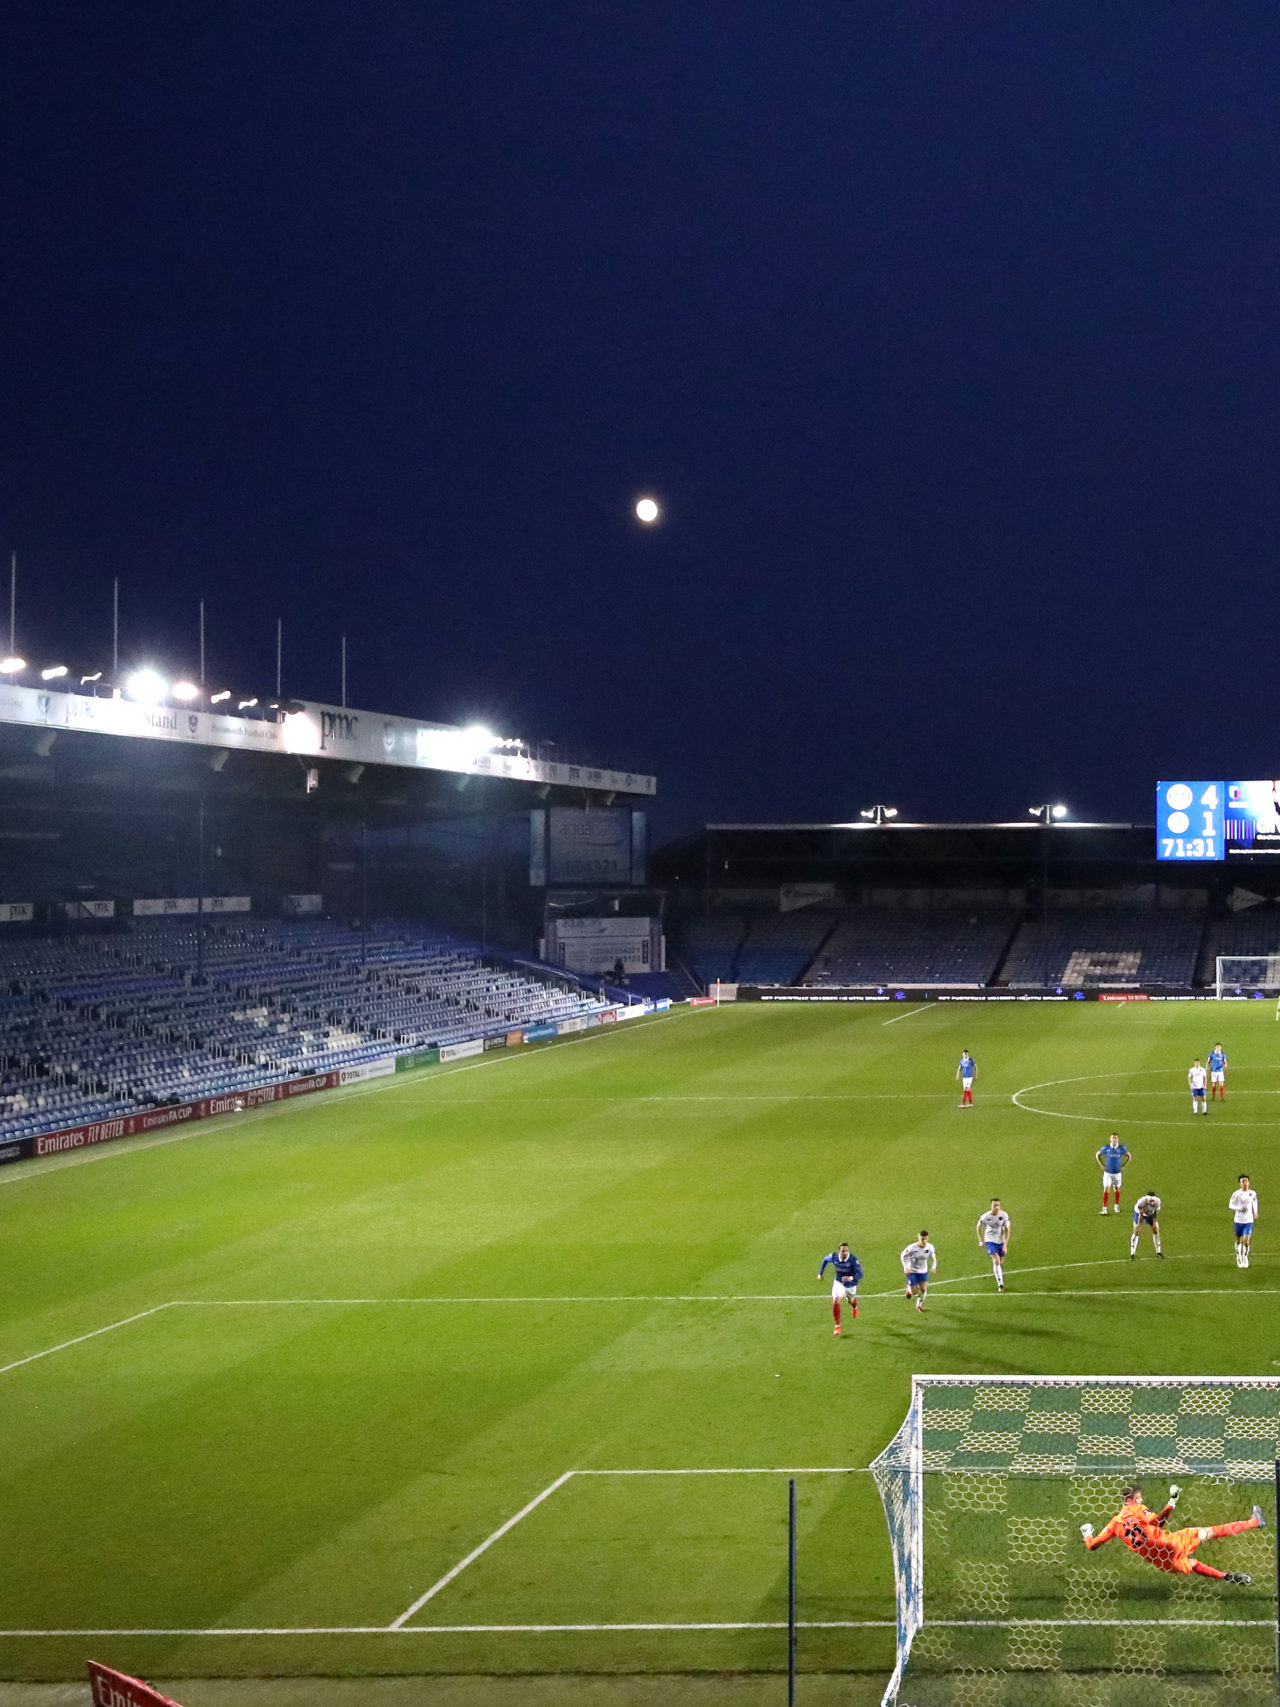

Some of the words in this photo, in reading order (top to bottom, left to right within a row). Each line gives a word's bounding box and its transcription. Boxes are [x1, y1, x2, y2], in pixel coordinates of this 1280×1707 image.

[319, 709, 360, 751] pmc
[1200, 785, 1219, 810] 4
[1202, 811, 1216, 837] 1
[1161, 838, 1216, 857] 71:31
[316, 1077, 327, 1087] CUP
[143, 1116, 169, 1128] Emirates
[169, 1110, 178, 1120] FA
[178, 1107, 193, 1119] CUP
[37, 1131, 85, 1155] Emirates
[88, 1125, 100, 1143] FLY
[100, 1119, 125, 1140] BETTER
[97, 1675, 141, 1707] Emi
